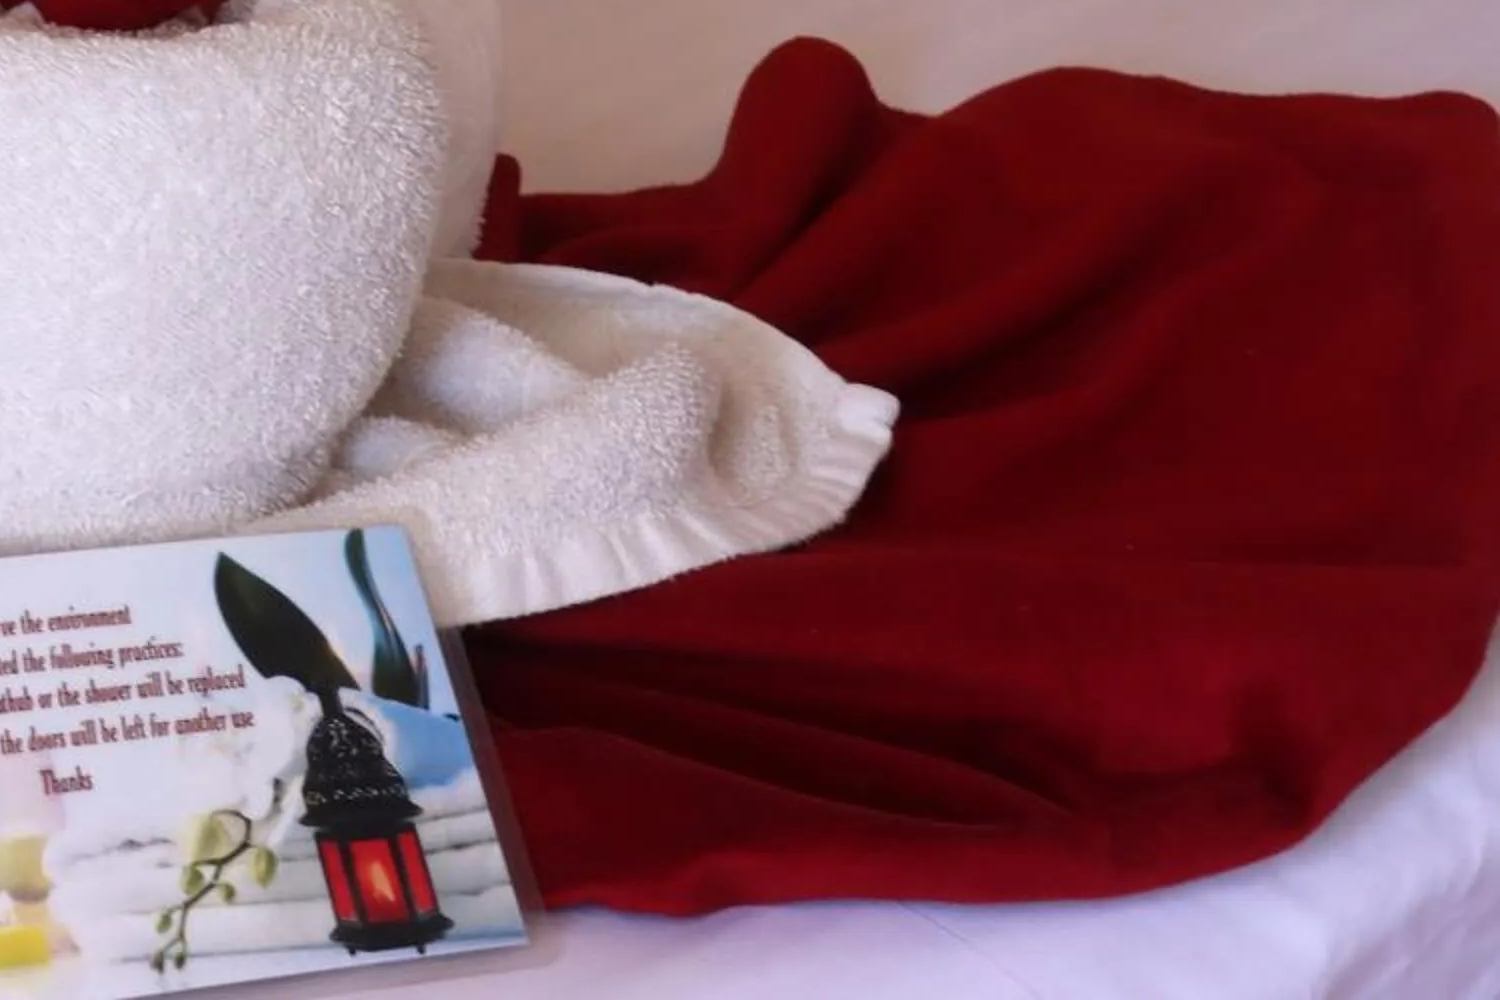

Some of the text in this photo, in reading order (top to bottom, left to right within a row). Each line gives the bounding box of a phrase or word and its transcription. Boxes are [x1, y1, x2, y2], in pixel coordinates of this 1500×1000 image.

[20, 609, 43, 634] the
[47, 604, 131, 631] environment
[23, 647, 46, 672] the
[50, 643, 115, 669] following
[118, 635, 184, 667] practices:
[38, 693, 53, 708] or
[57, 681, 81, 707] the
[85, 678, 132, 704] shower
[136, 671, 164, 698] will
[165, 671, 184, 695] be
[187, 663, 246, 698] replaced
[0, 728, 24, 754] the
[28, 725, 67, 751] doors
[70, 719, 98, 746] will
[99, 717, 117, 743] be
[120, 715, 146, 741] left
[149, 712, 170, 737] for
[174, 707, 226, 735] another
[231, 711, 255, 729] use
[39, 765, 93, 796] Thanks
